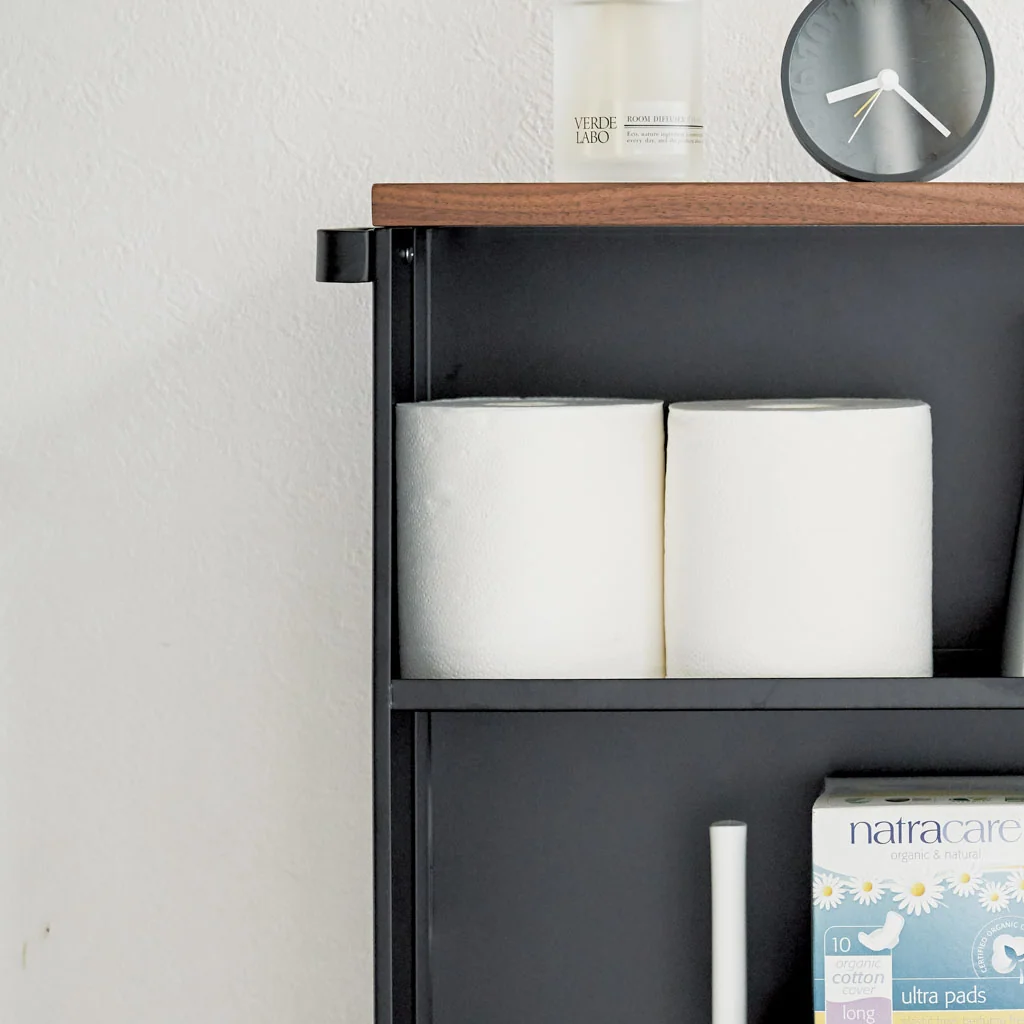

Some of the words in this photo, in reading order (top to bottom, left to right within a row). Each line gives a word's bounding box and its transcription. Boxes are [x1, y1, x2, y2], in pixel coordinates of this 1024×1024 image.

[574, 116, 617, 130] VERDE
[576, 131, 610, 144] LABO
[850, 817, 1022, 845] natracare
[890, 850, 930, 863] organic
[933, 850, 941, 860] &
[945, 849, 982, 860] natural
[832, 937, 851, 952] 10
[977, 936, 988, 973] CERTIFIED
[987, 922, 1019, 936] ORGANIC
[836, 960, 881, 971] organic
[832, 972, 885, 984] cotton
[842, 986, 876, 995] cover
[901, 985, 938, 1004] ultra
[945, 985, 987, 1007] pads
[843, 1005, 875, 1024] long
